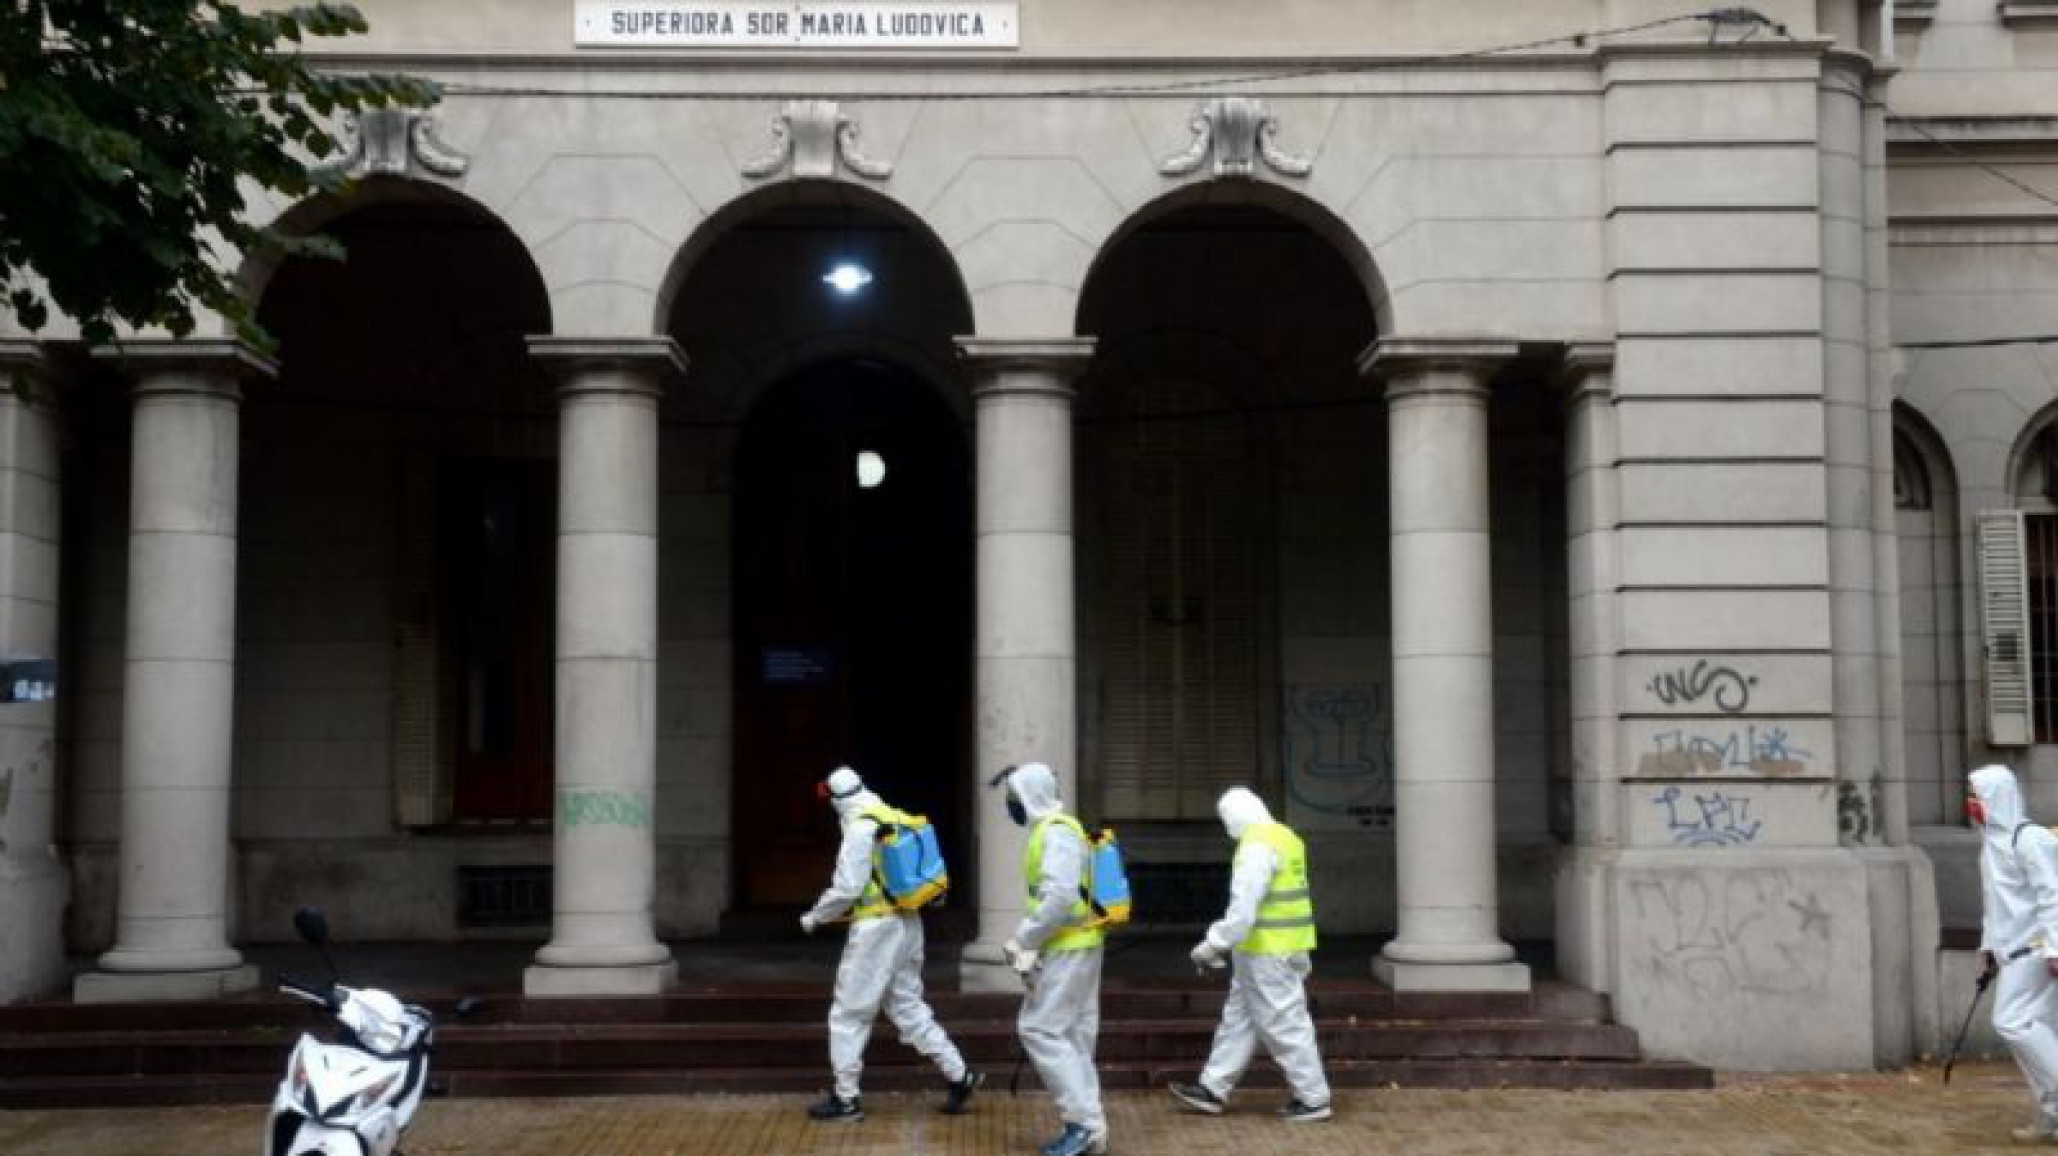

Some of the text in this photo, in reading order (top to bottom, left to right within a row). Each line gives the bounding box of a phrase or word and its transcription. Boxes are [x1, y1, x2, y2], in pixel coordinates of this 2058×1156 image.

[611, 11, 985, 37] SUPERIORA SOR MARIA LUDOVICA
